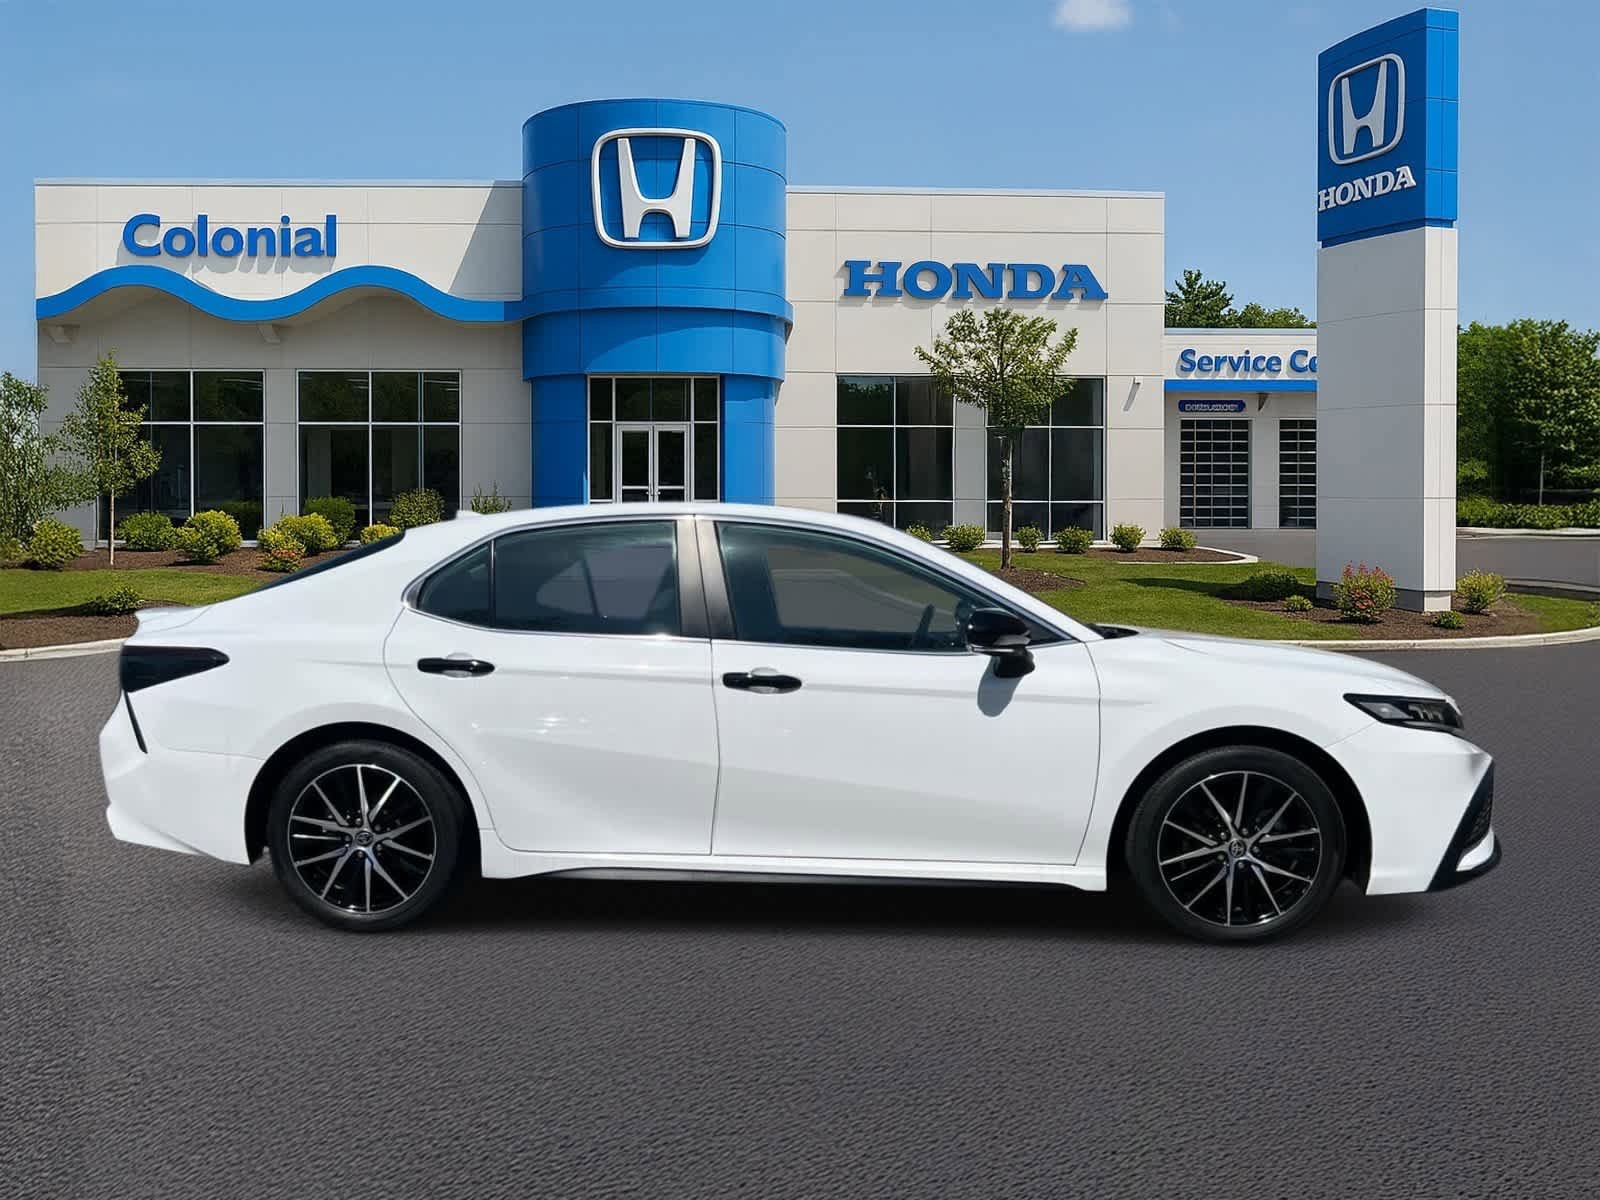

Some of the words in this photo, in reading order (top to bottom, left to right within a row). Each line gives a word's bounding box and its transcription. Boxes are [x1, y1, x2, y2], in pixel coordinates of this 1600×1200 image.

[1318, 165, 1417, 211] HONDA
[123, 213, 337, 257] Colonial
[843, 260, 1108, 300] HONDA
[1179, 349, 1282, 373] Service
